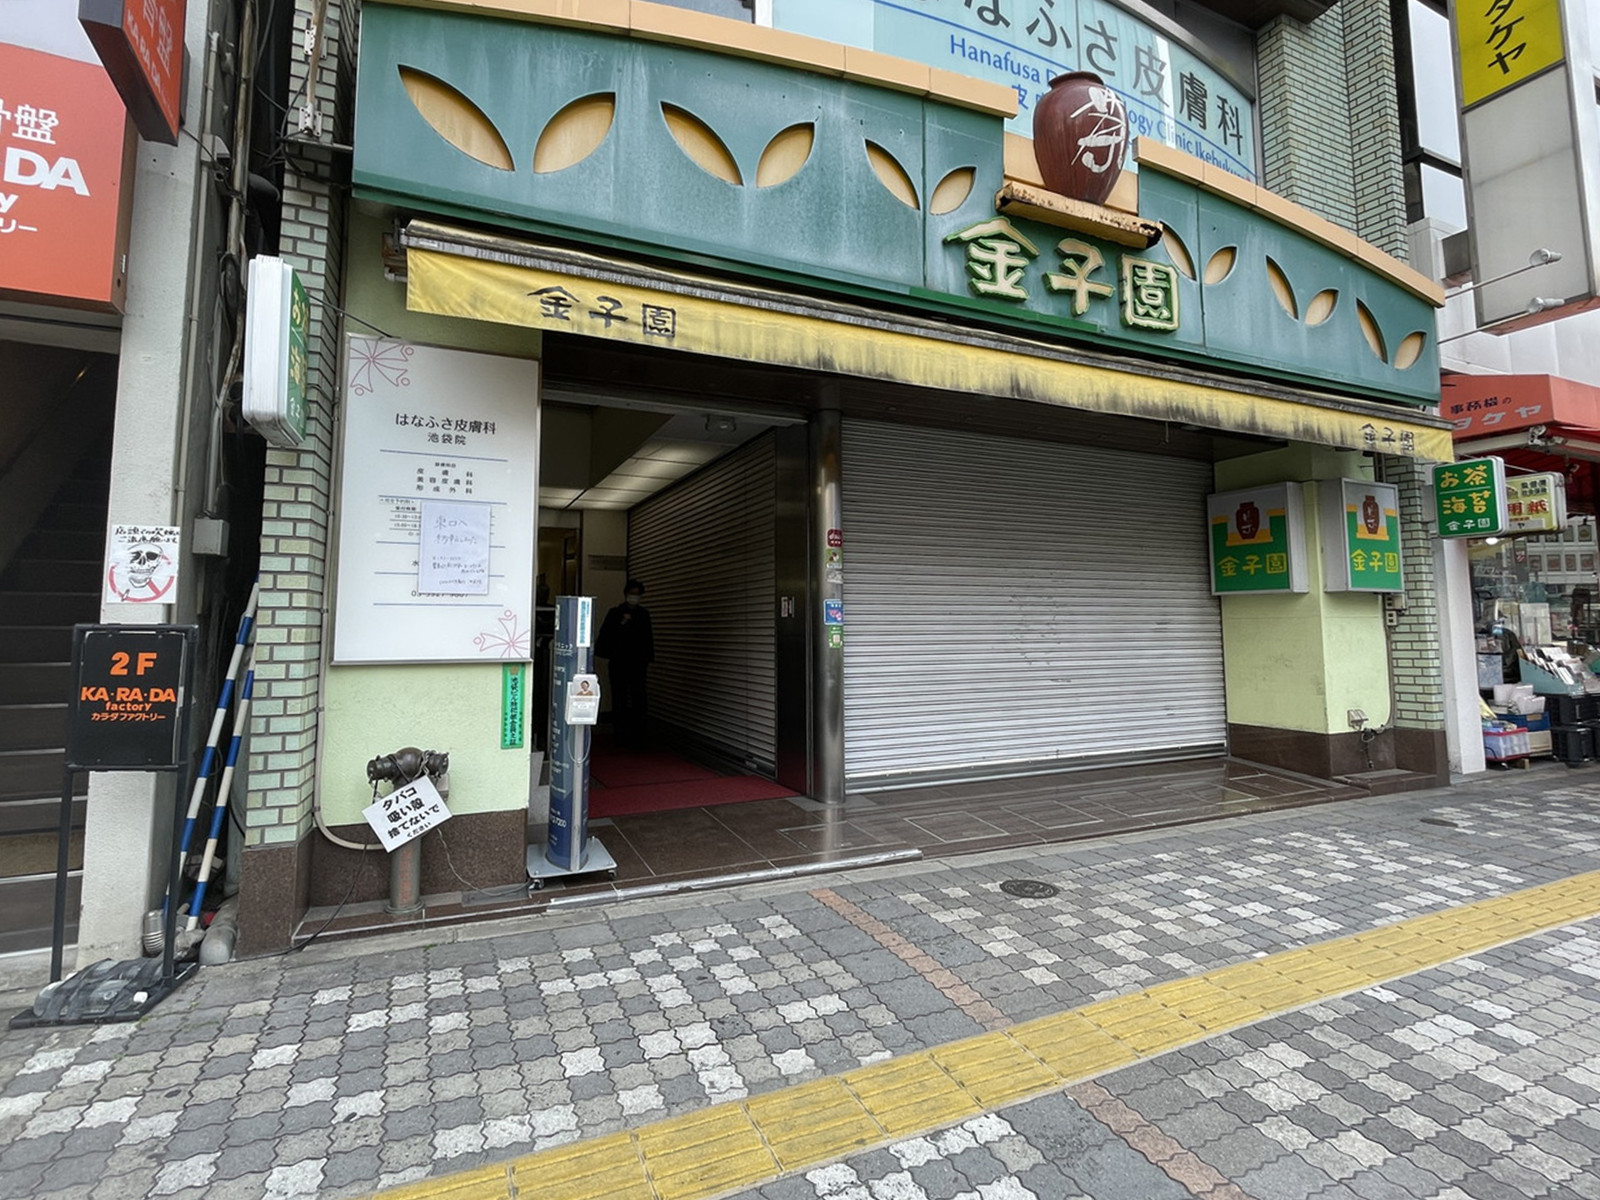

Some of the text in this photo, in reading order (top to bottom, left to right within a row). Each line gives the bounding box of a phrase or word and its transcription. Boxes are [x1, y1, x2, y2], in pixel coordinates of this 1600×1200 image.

[1484, 0, 1527, 75] タケヤ
[950, 34, 1041, 84] Hanafusa
[942, 215, 1181, 332] 金子園
[527, 285, 676, 339] 金子園
[395, 413, 496, 435] はなふさ皮膚科
[427, 432, 467, 446] 池袋院
[1440, 464, 1488, 488] お茶
[1442, 490, 1491, 515] 海苔
[1446, 517, 1491, 532] 金子園
[1217, 553, 1287, 577] 金子園
[1351, 548, 1399, 573] 金子園
[91, 712, 166, 722] カラダファクトリー
[105, 701, 152, 713] factory
[382, 786, 418, 811] タバコ
[387, 797, 425, 823] 吸い殻
[387, 803, 440, 839] 捨てないで
[406, 822, 432, 838] ください
